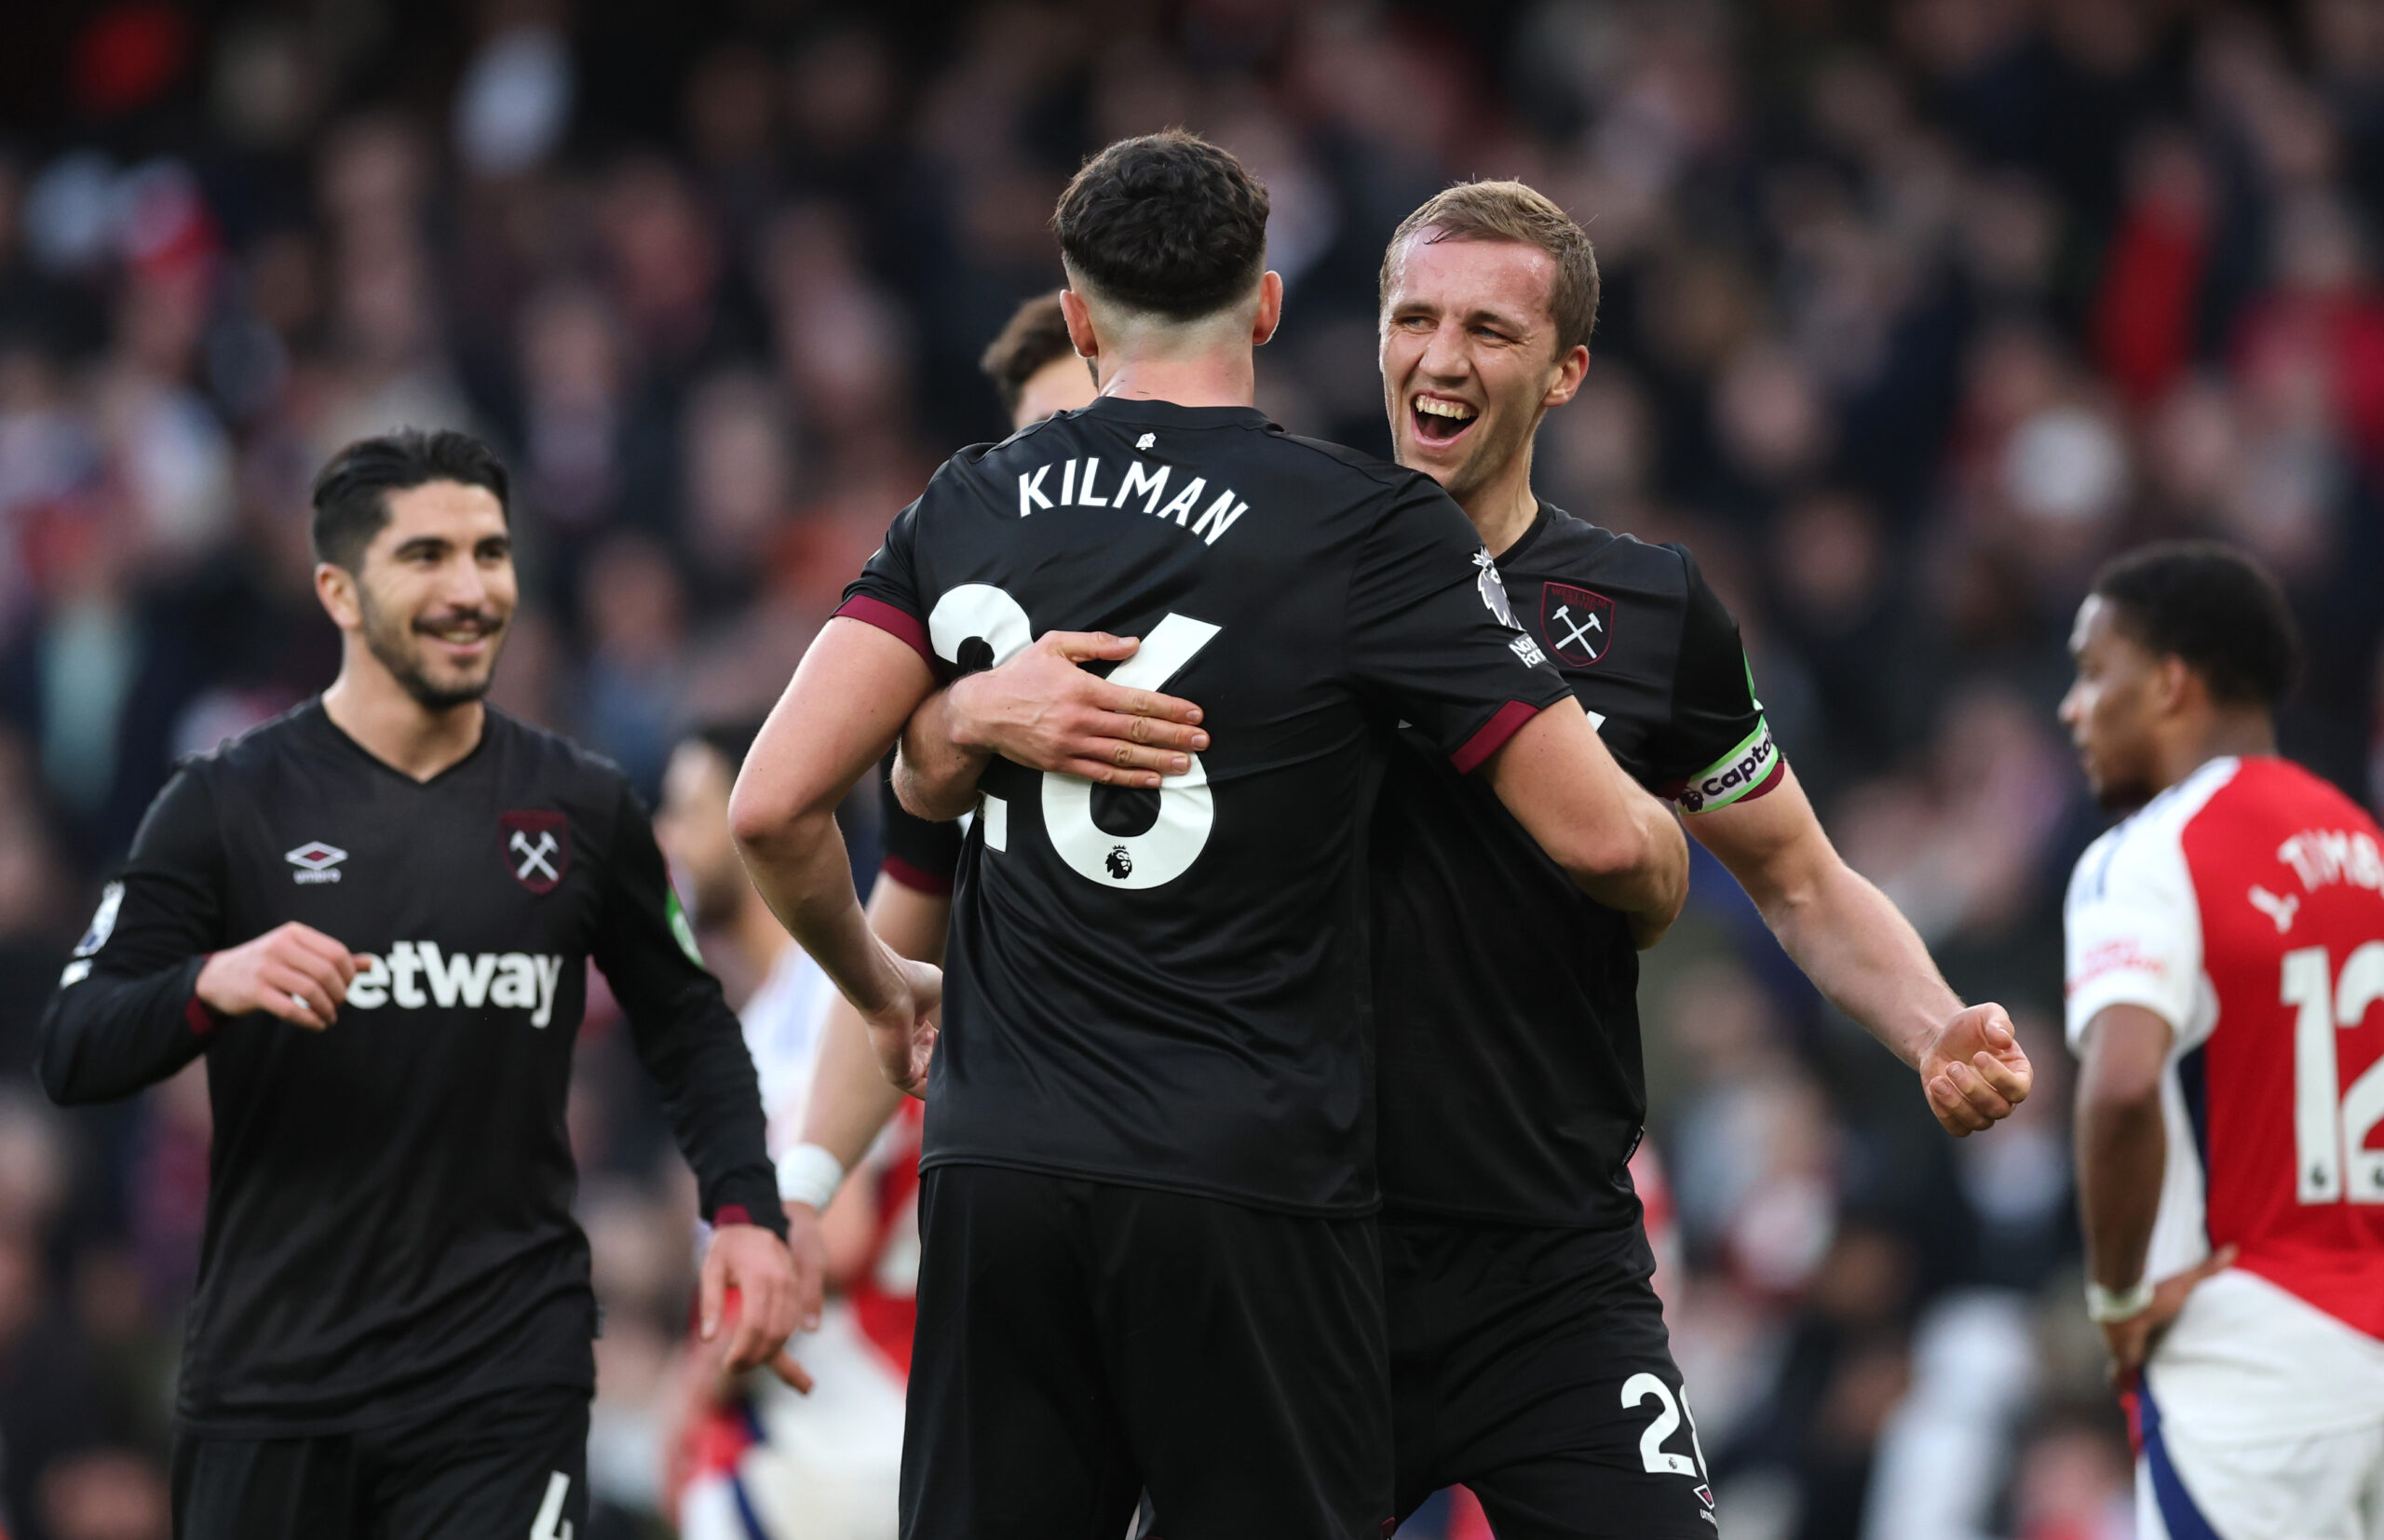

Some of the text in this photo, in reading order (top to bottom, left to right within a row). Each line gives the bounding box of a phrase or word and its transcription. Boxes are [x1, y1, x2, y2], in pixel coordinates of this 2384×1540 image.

[1019, 457, 1250, 546] KILMAN
[1701, 727, 1772, 796] Capta
[2276, 828, 2384, 896] TIMB
[345, 939, 562, 1029] etway
[2280, 939, 2384, 1206] 12
[1620, 1372, 1710, 1486] 2
